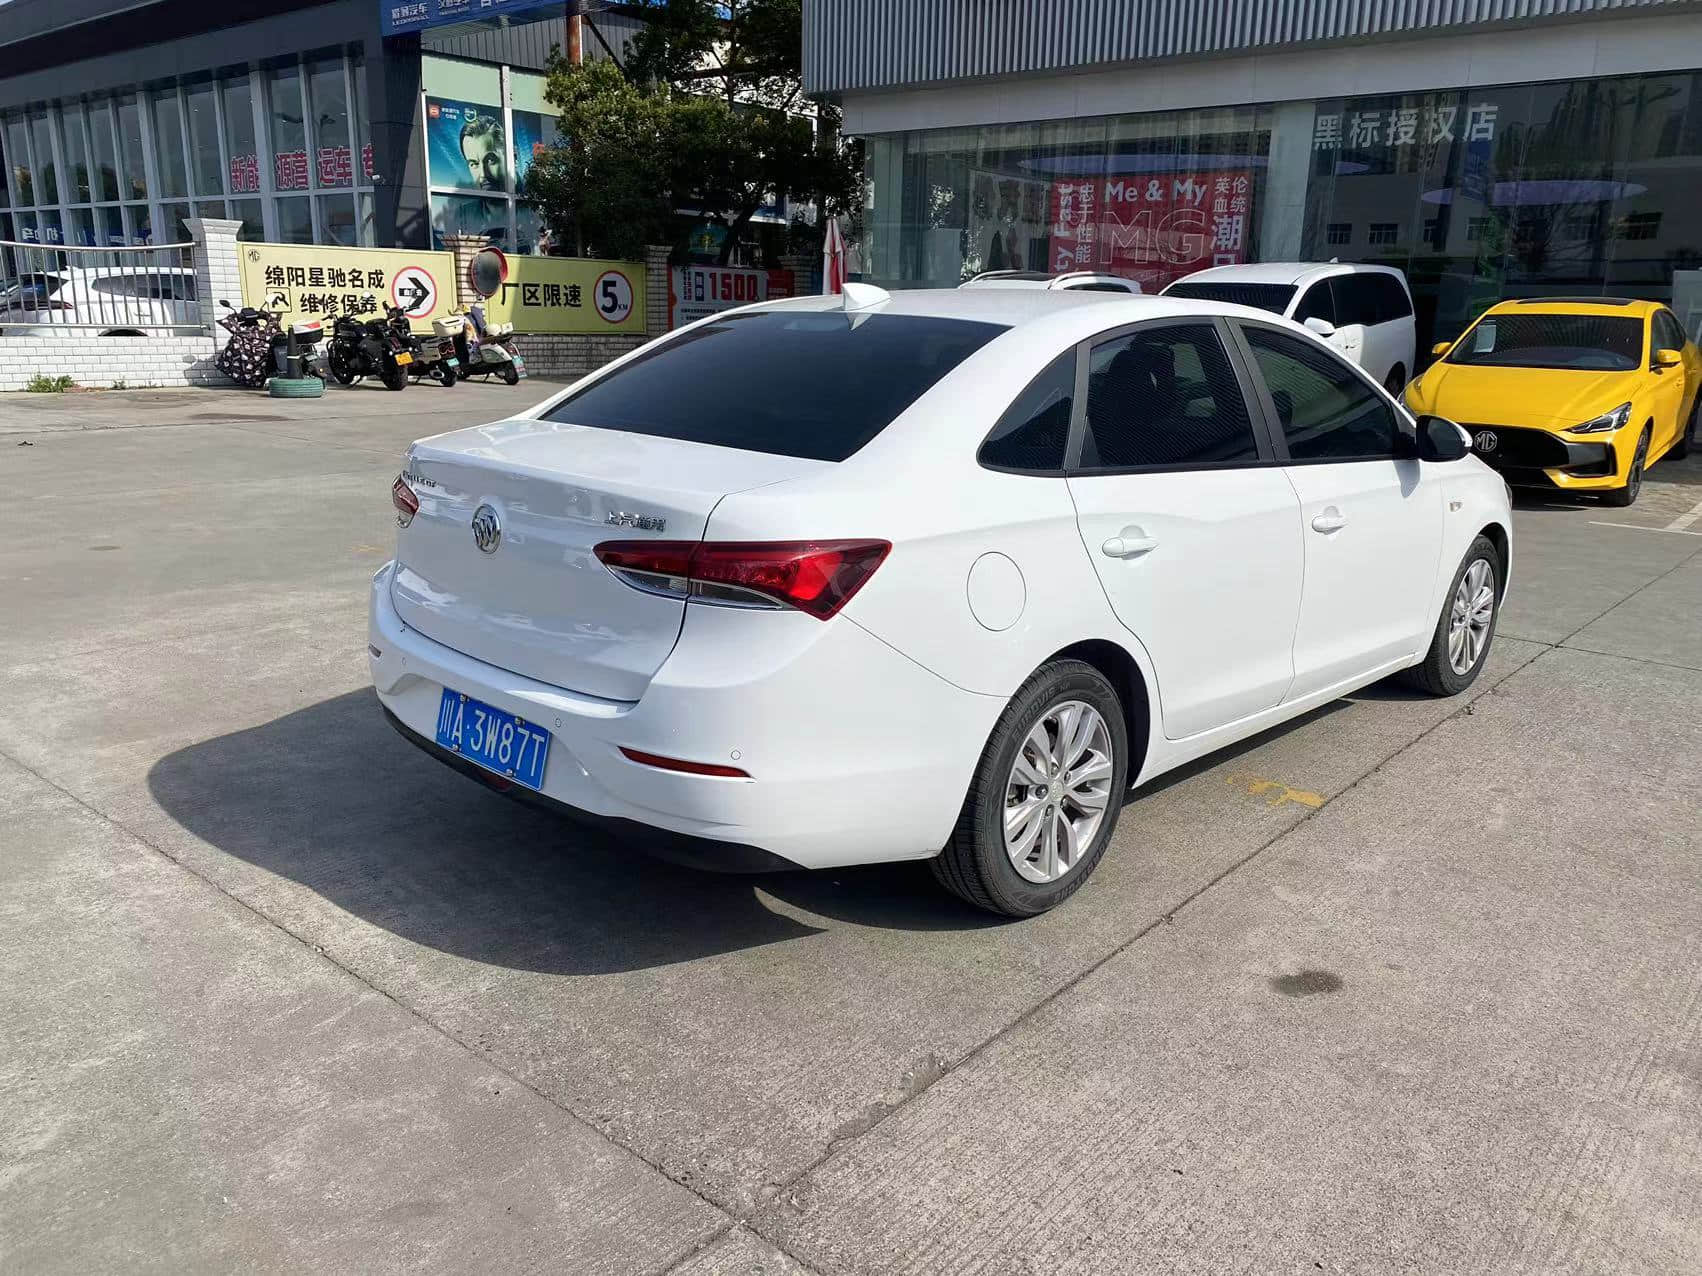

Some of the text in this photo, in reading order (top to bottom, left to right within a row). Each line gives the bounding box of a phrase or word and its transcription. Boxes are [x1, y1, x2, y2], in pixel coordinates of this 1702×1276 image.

[1314, 102, 1499, 150] 黑标授权店
[1104, 178, 1208, 206] Me & My
[1054, 184, 1074, 237] Fast
[1075, 182, 1095, 263] 忠于性能
[1100, 208, 1206, 265] MG
[265, 265, 385, 288] 绵阳星驰名成
[709, 272, 758, 301] 1500
[300, 293, 377, 315] 维修保养
[500, 283, 582, 308] 厂区限速
[1475, 432, 1496, 451] MG
